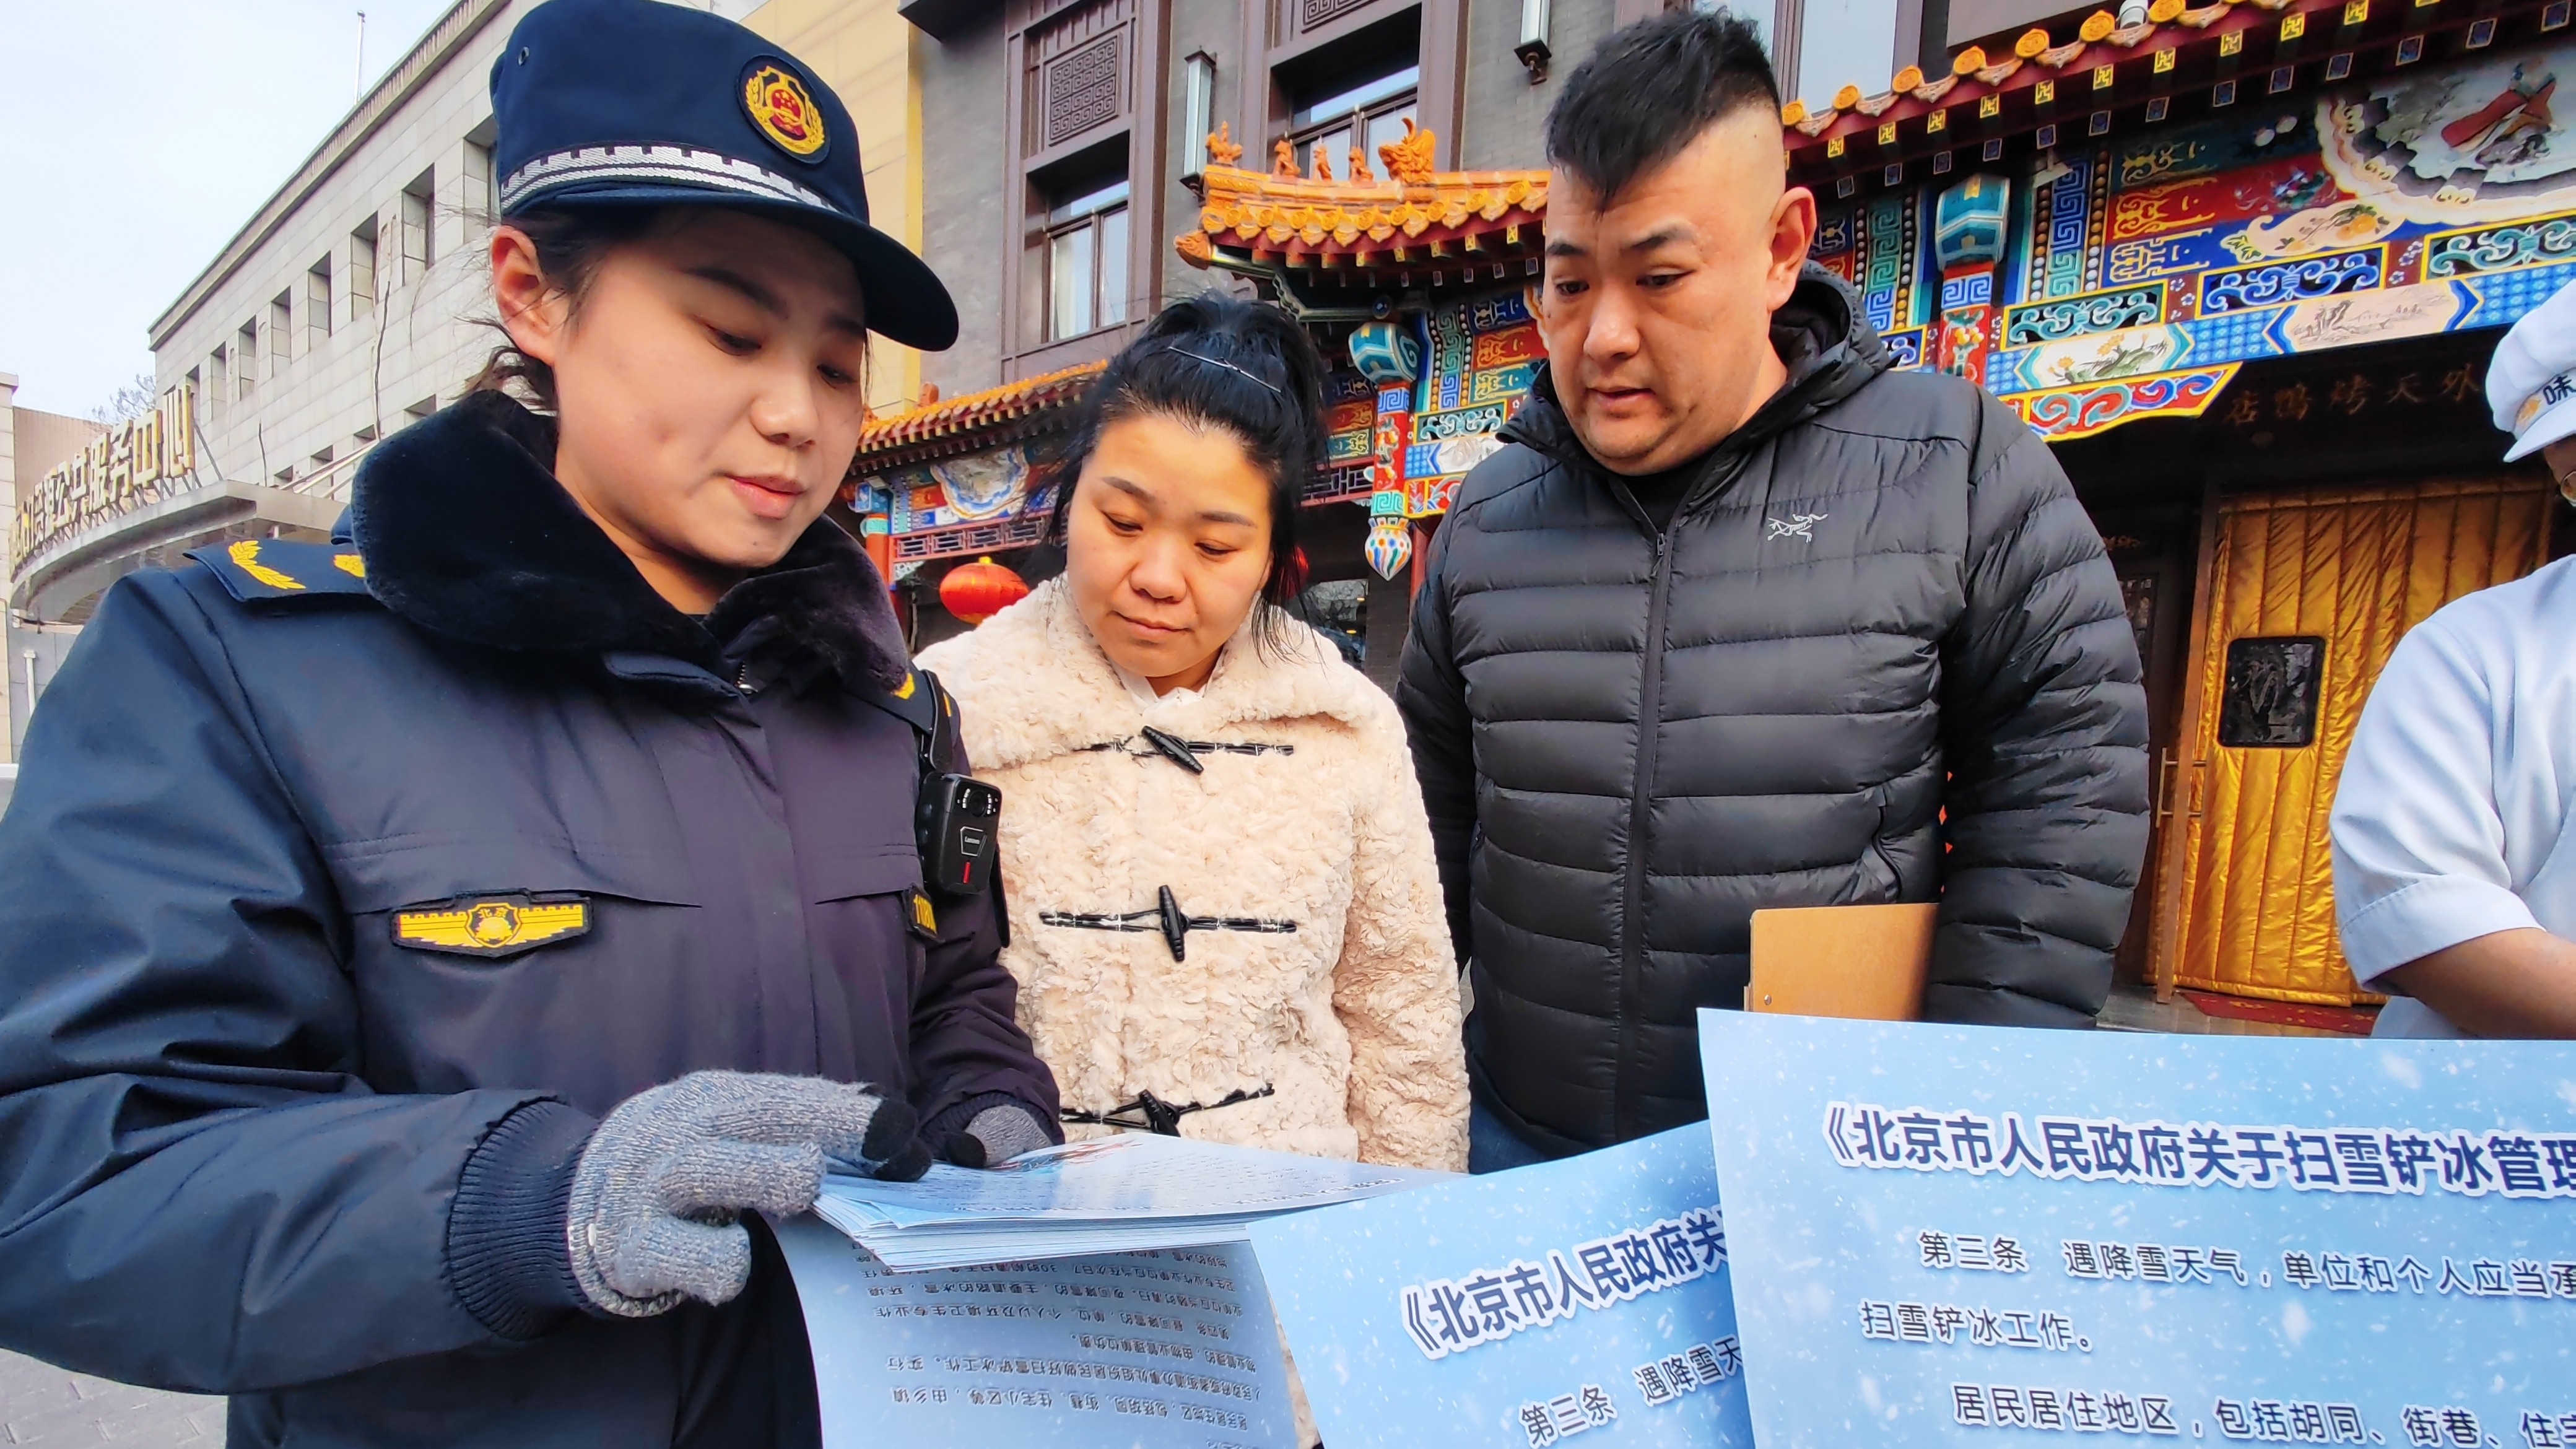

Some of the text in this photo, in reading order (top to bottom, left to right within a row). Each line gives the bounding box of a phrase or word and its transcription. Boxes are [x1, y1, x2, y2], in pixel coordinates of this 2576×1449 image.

[2543, 375, 2576, 406] 味
[477, 907, 509, 918] 北京
[1828, 1107, 2576, 1193] 《北京市人民政府关于扫雪铲冰管理
[1920, 1233, 2027, 1271] 第三条
[1405, 1208, 1727, 1352] 《北京市人民政府关
[1861, 1301, 2093, 1352] 扫雪铲冰工作。
[1520, 1337, 1742, 1445] 第三条 遇降雪天
